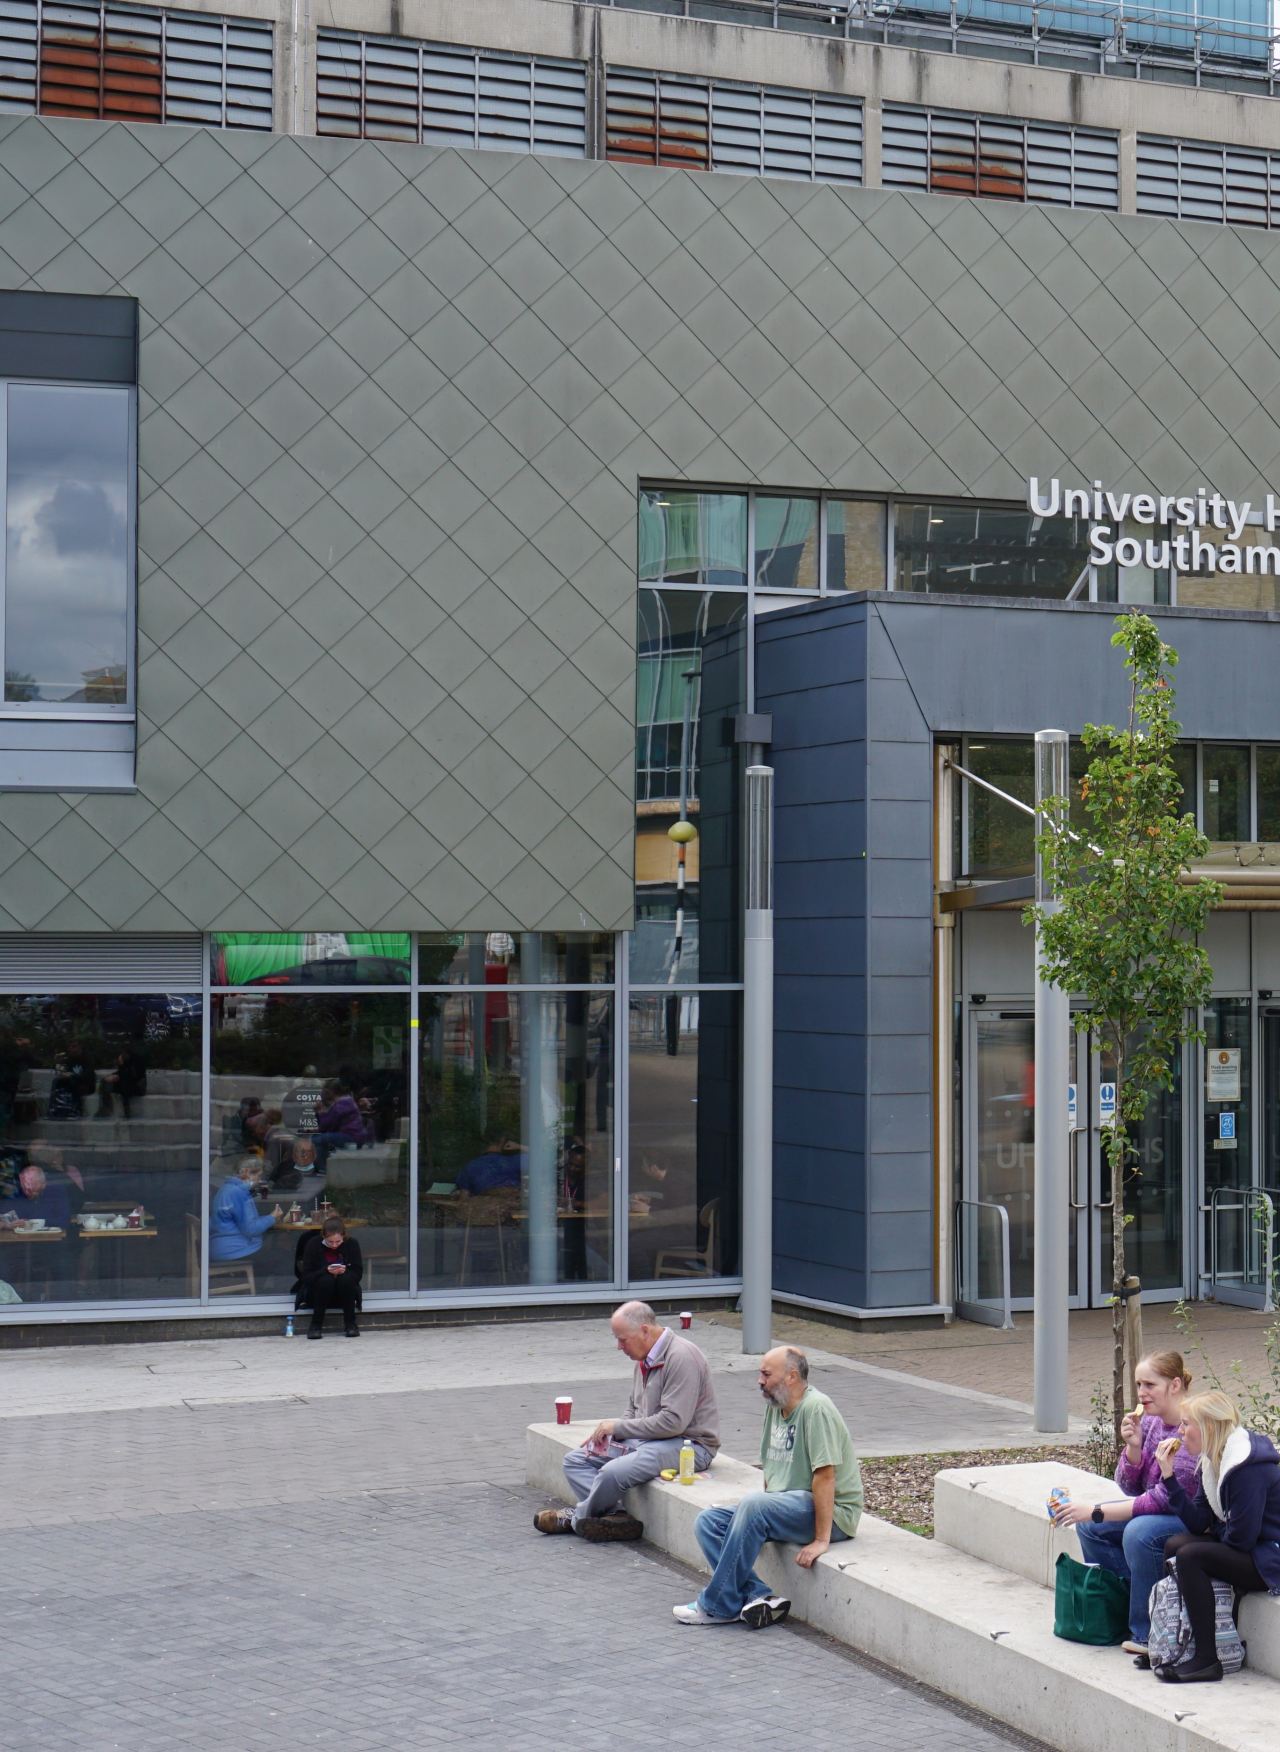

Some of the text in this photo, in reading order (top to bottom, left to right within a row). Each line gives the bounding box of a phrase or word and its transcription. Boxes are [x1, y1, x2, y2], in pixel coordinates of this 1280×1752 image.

[1028, 477, 1251, 541] University
[299, 1118, 318, 1126] M&S
[997, 1143, 1035, 1168] UH
